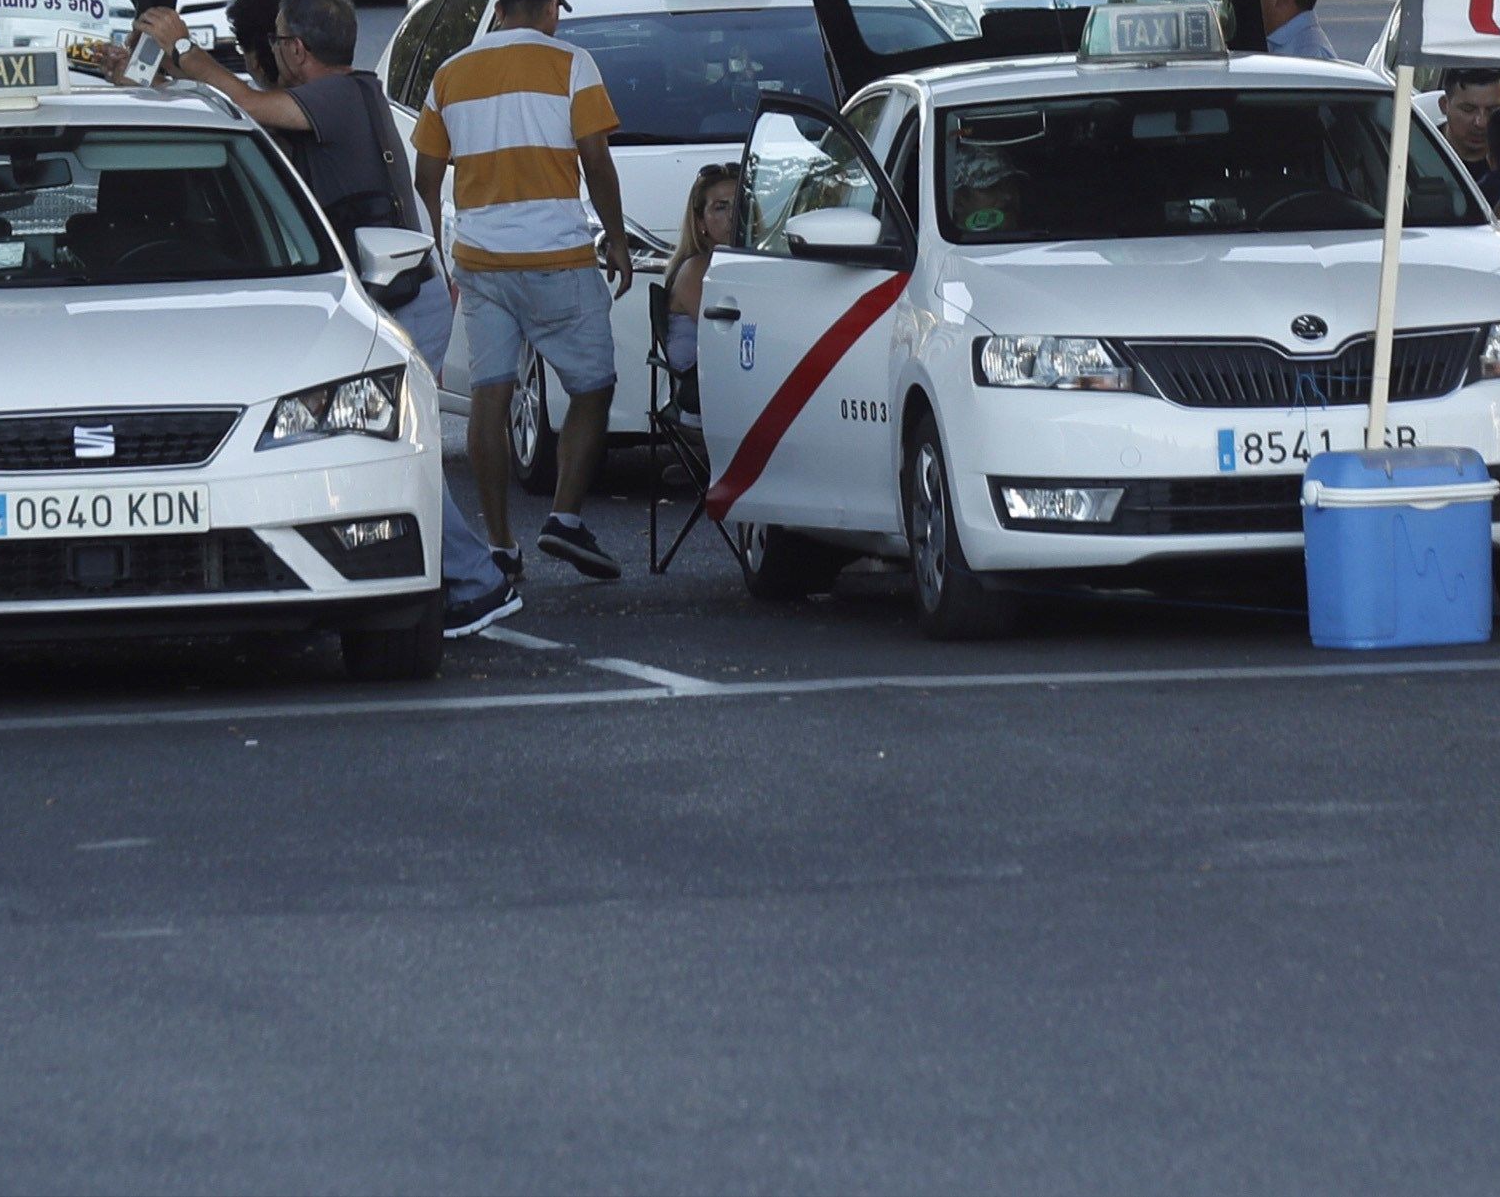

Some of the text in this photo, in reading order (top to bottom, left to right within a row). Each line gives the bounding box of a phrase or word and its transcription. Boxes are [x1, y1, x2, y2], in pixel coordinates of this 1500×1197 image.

[1120, 18, 1178, 47] TAXI
[841, 398, 891, 423] 05603
[1243, 429, 1331, 466] 8541
[15, 490, 200, 531] 0640 KDN
